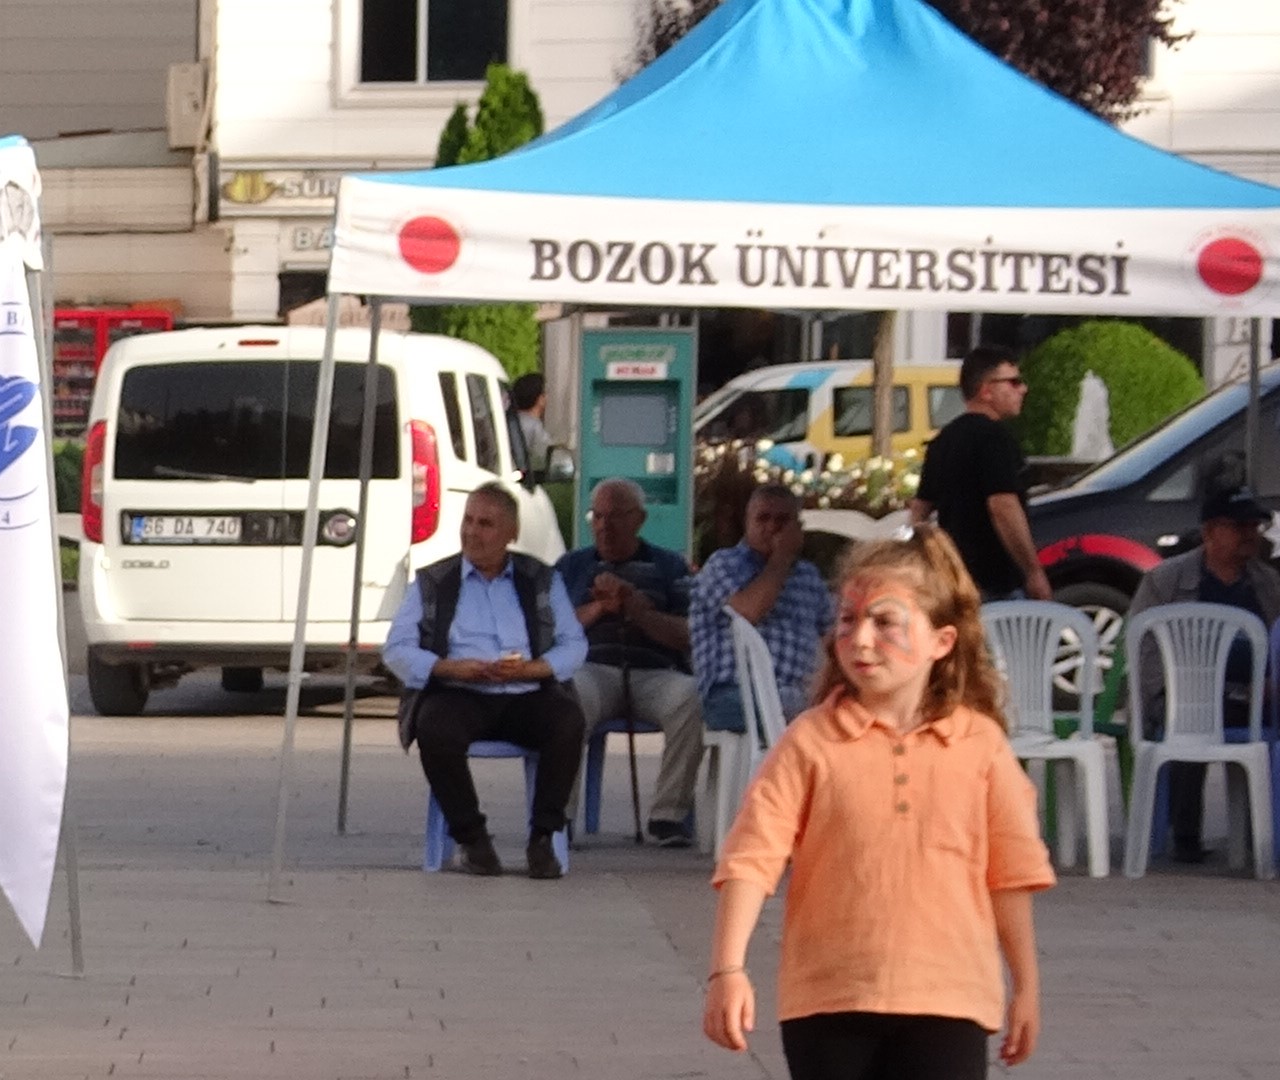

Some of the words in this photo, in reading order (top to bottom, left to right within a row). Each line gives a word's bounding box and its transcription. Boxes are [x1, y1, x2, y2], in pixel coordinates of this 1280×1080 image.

[530, 237, 717, 284] BOZOK
[736, 228, 1131, 296] ÜNİVERSİTESİ
[206, 517, 239, 534] 740
